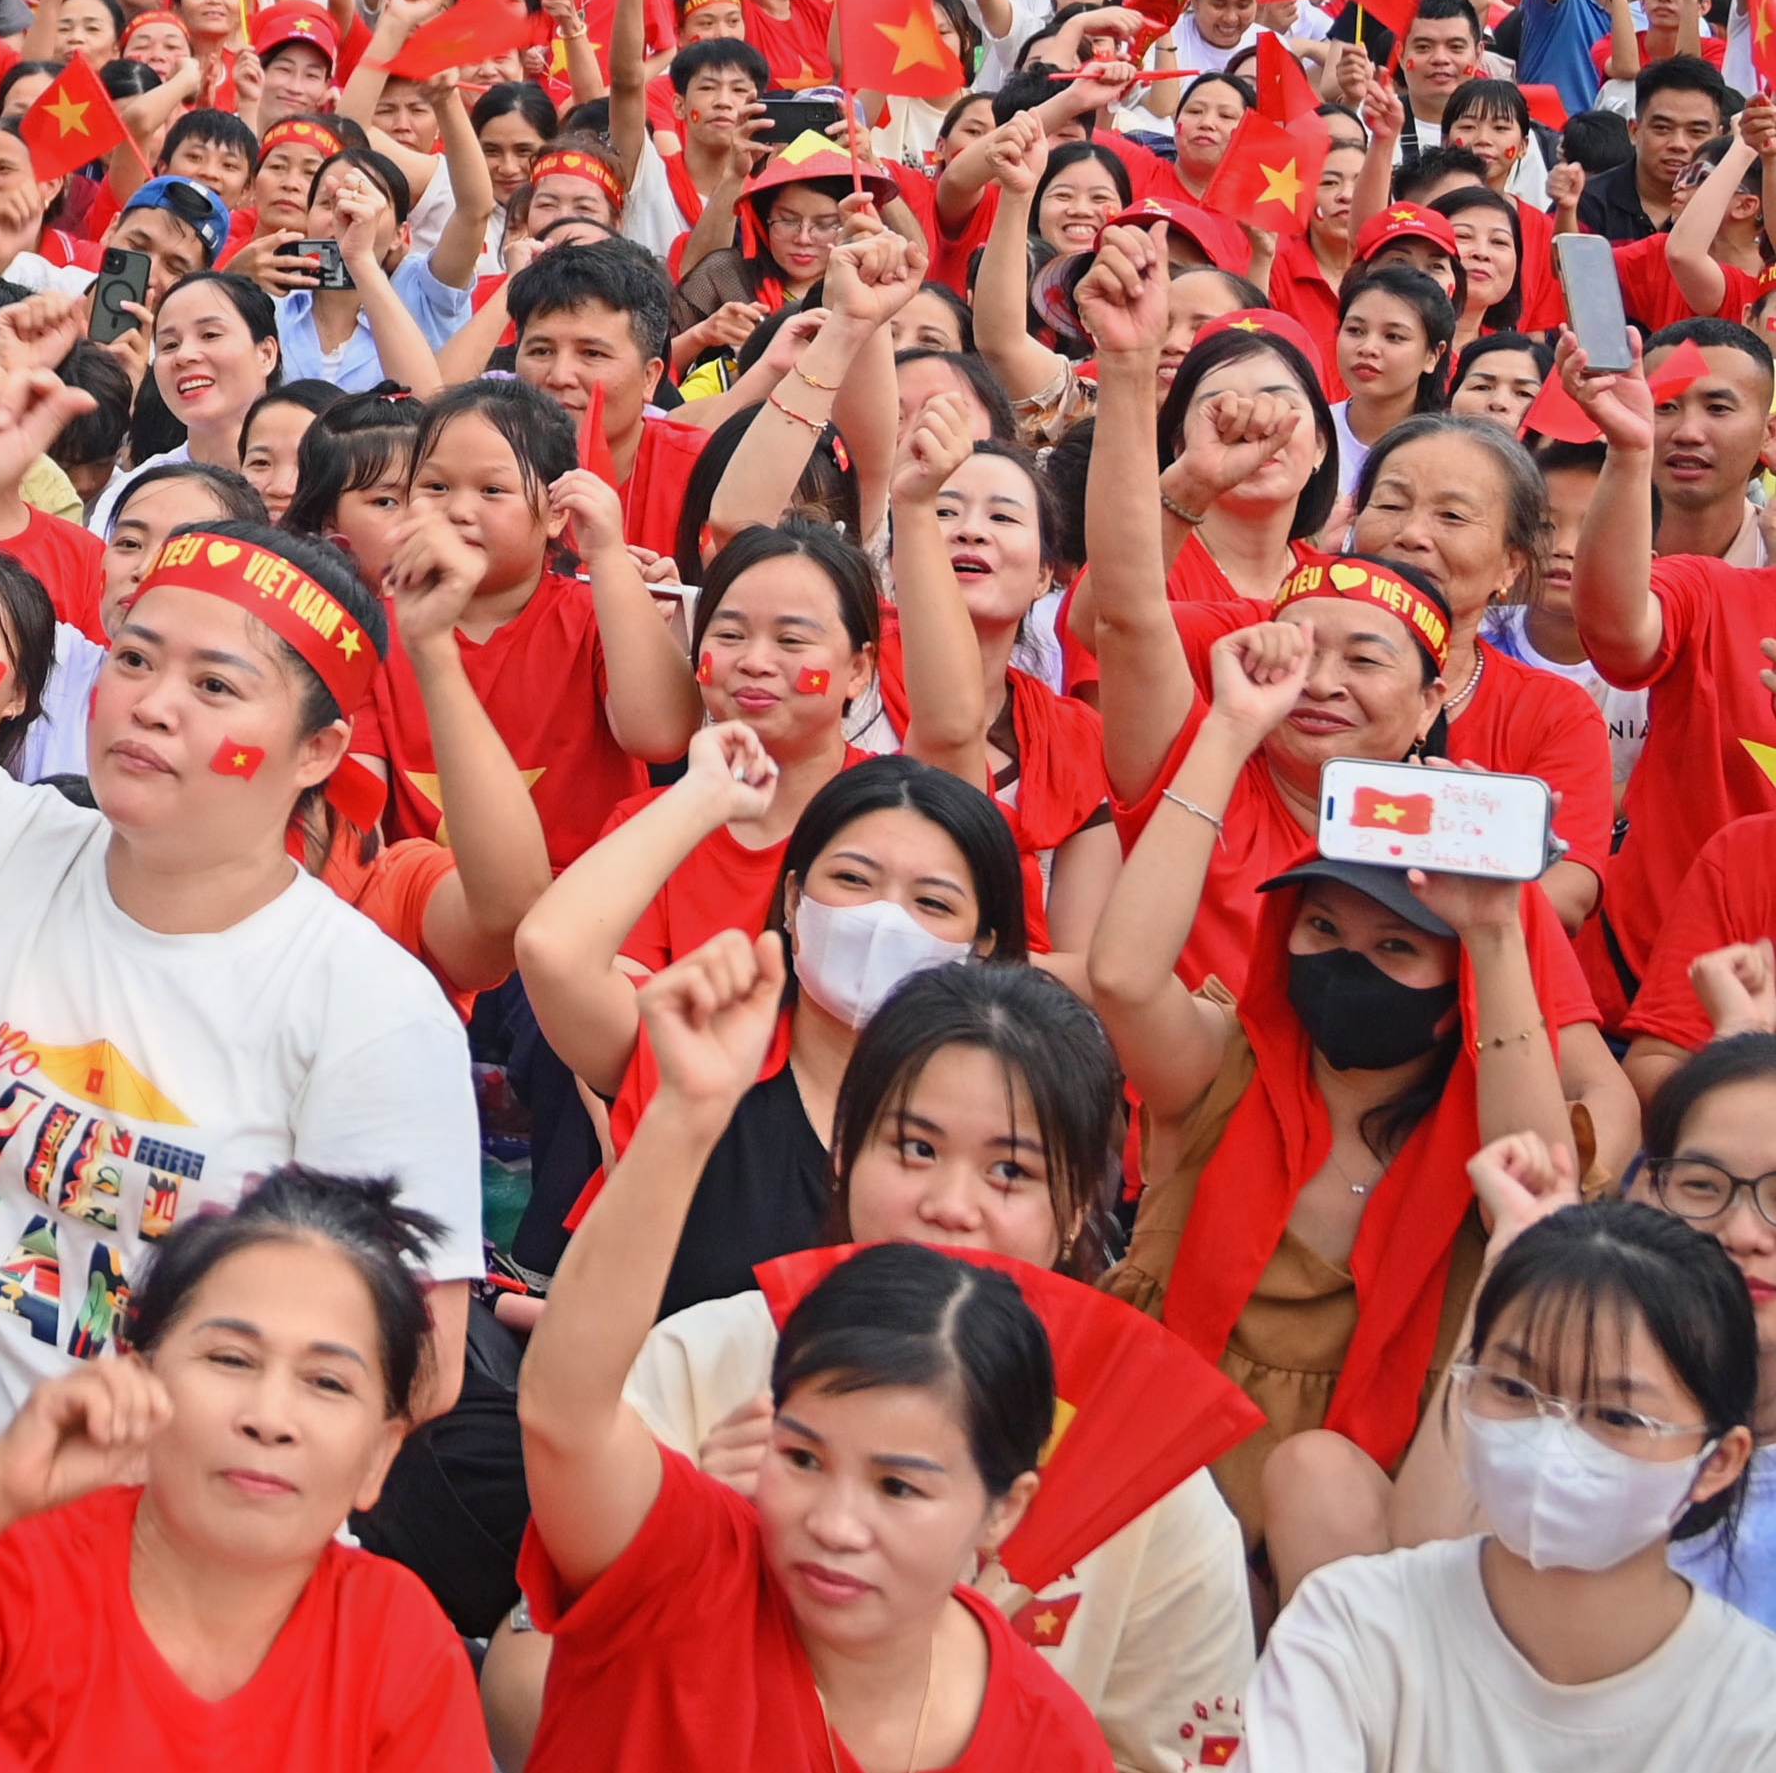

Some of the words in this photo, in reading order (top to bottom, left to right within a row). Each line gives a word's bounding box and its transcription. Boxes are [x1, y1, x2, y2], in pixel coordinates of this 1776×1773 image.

[157, 532, 205, 570] YÊU
[243, 550, 299, 602] VIỆT
[289, 585, 345, 641] NAM
[1370, 573, 1414, 612] VIỆT
[1411, 600, 1448, 646] NAM
